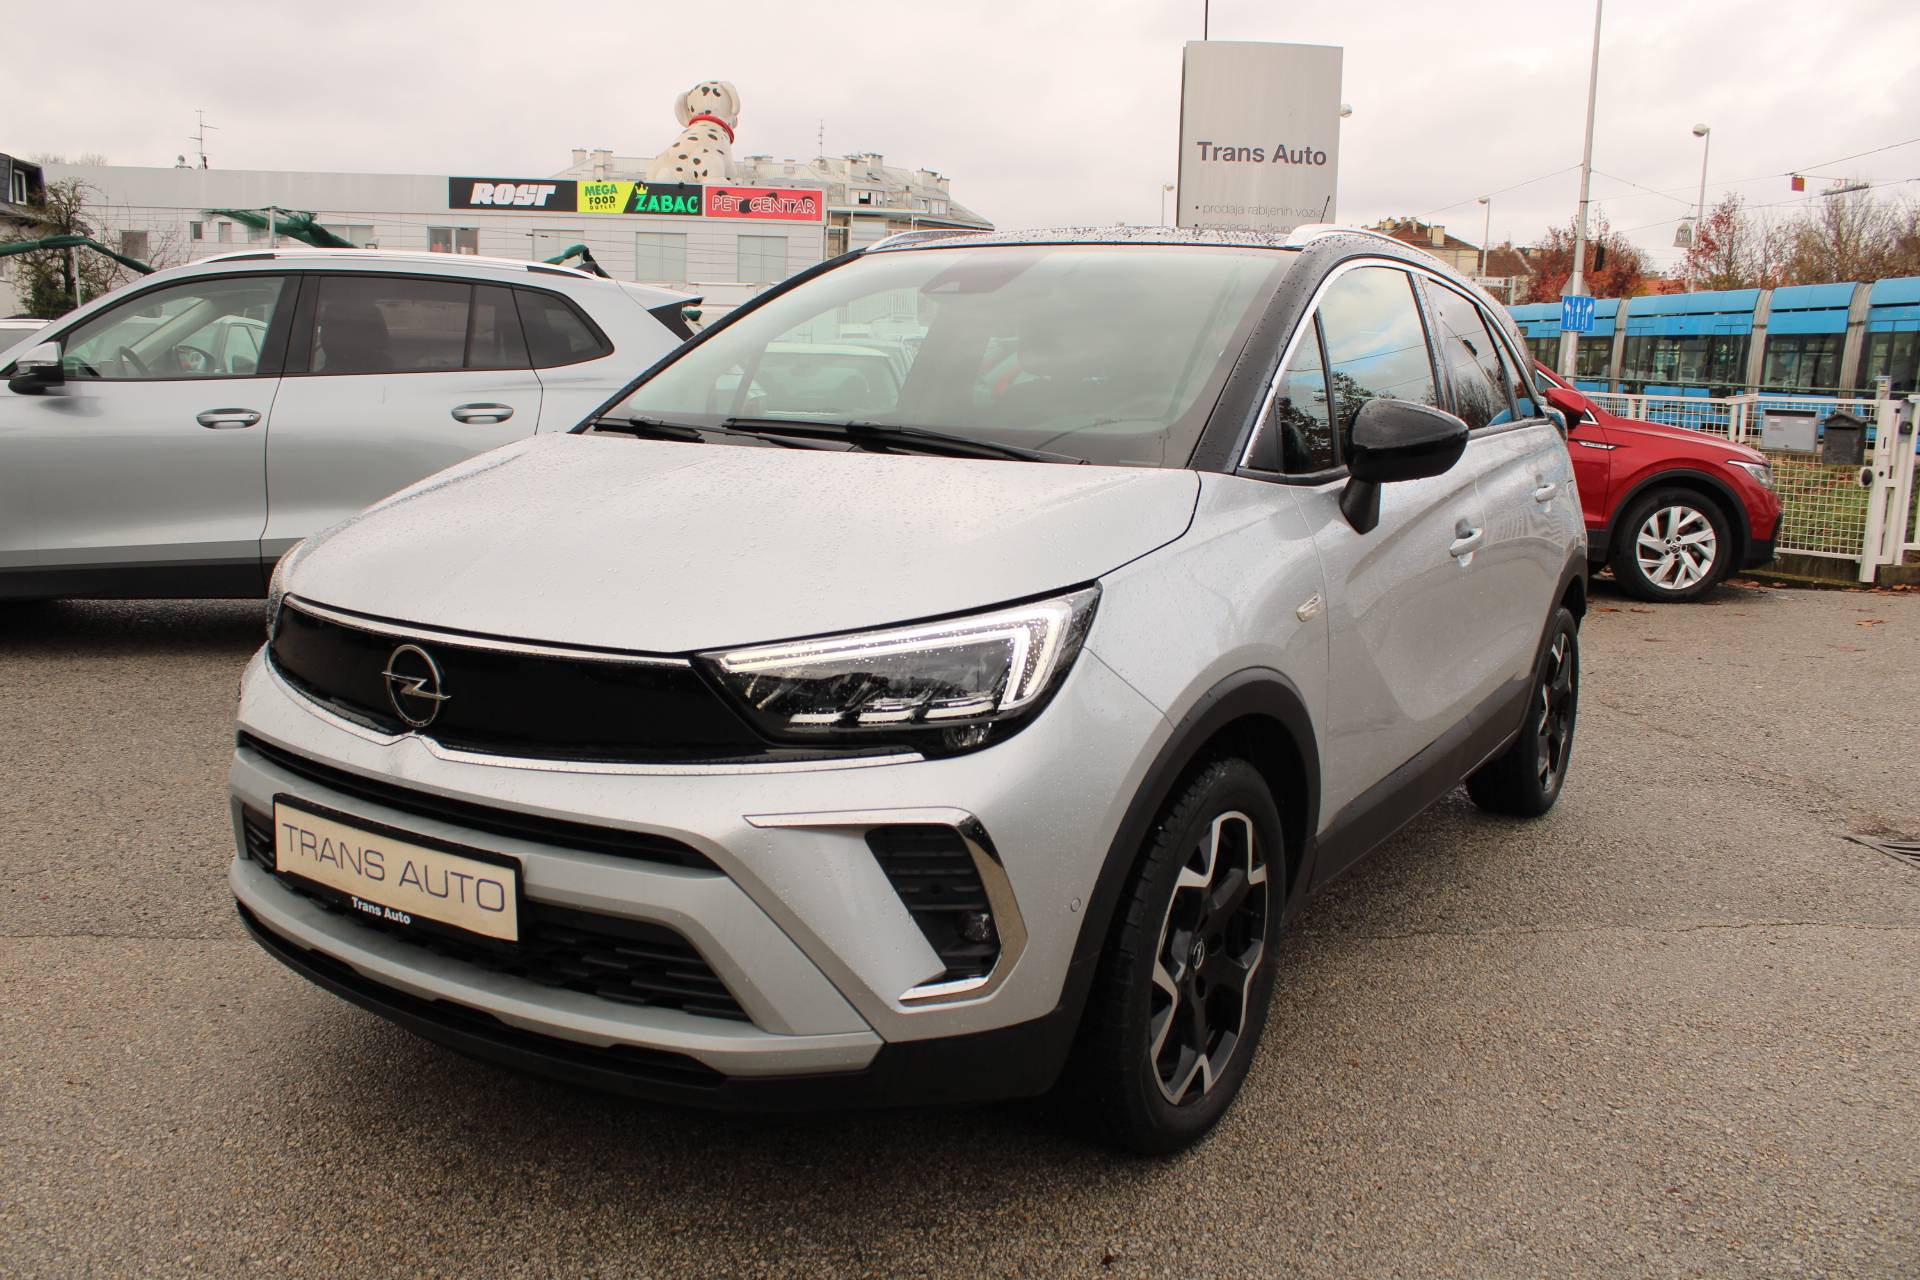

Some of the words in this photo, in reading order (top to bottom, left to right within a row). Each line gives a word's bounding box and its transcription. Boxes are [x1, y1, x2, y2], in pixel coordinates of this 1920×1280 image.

[1197, 141, 1265, 162] Trans
[1272, 144, 1327, 165] Auto
[469, 182, 556, 206] ROST
[585, 184, 618, 196] MEGA
[589, 196, 616, 205] FOOD
[712, 195, 743, 211] PET
[749, 197, 816, 214] CENTAR
[1202, 202, 1245, 216] prodaja
[282, 823, 385, 881] TRANS
[399, 860, 504, 913] AUTO
[351, 896, 382, 916] Trans
[384, 907, 411, 925] Auto
